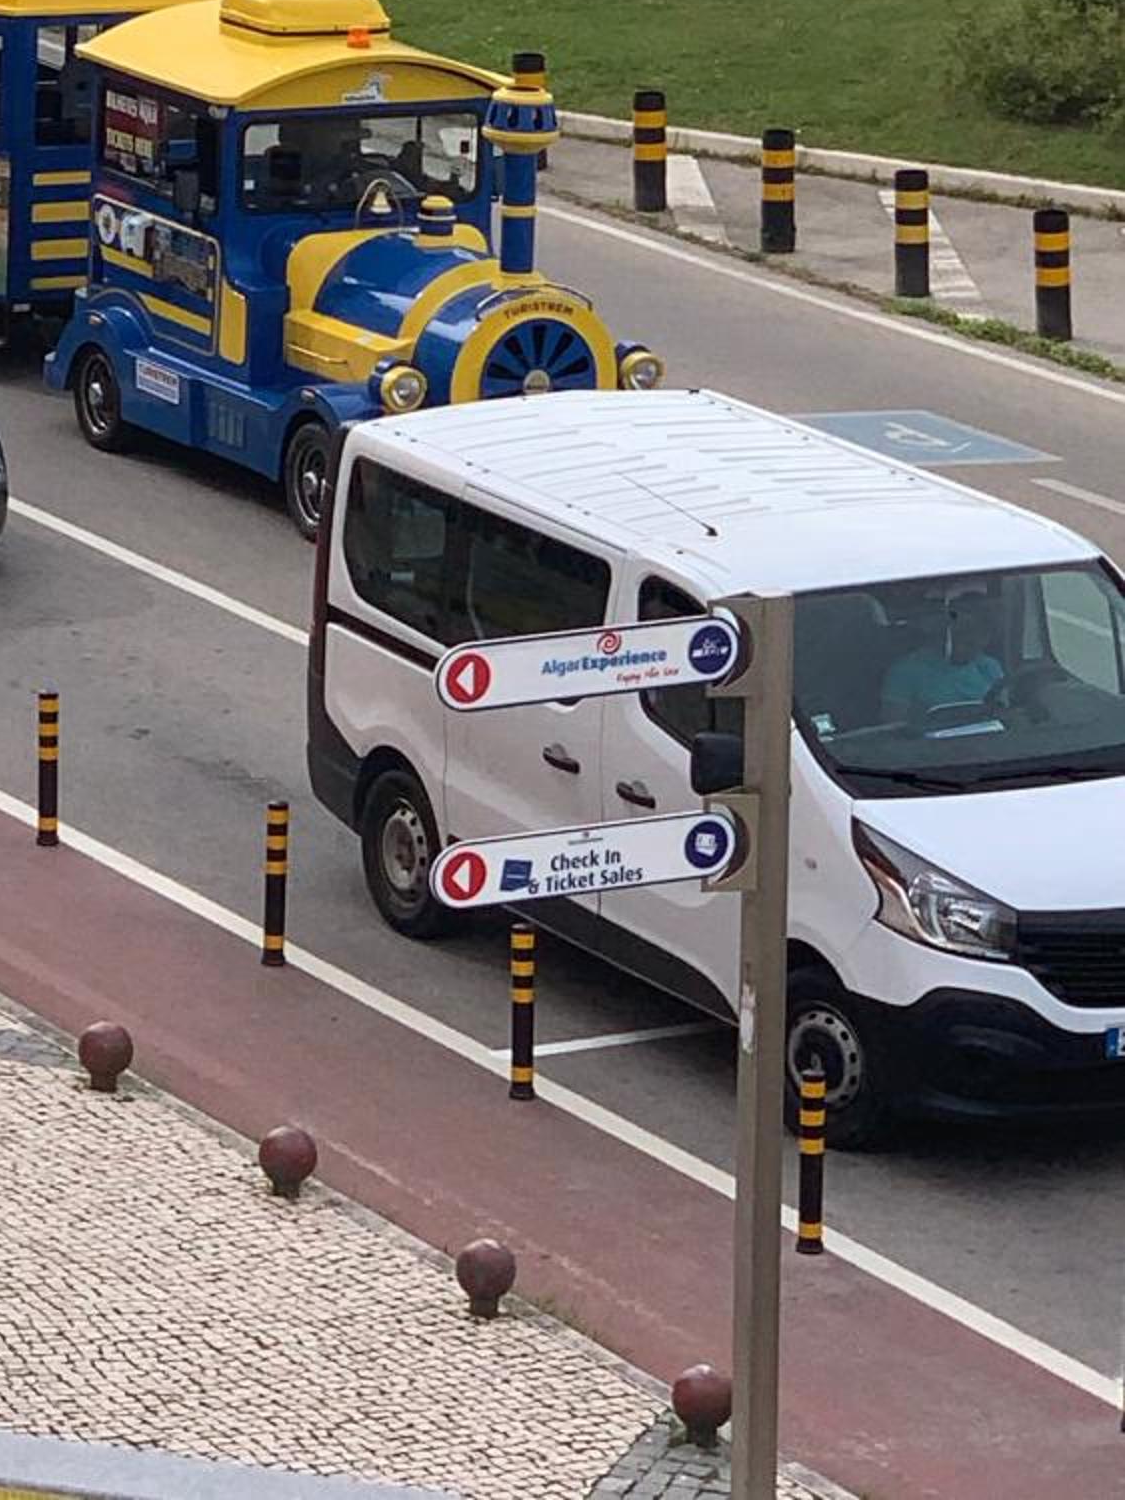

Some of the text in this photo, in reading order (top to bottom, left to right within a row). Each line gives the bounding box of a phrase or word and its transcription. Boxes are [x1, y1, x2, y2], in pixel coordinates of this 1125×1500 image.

[541, 650, 667, 676] AlgarExperience
[551, 849, 621, 871] Check In
[528, 866, 643, 894] & Ticket Sales
